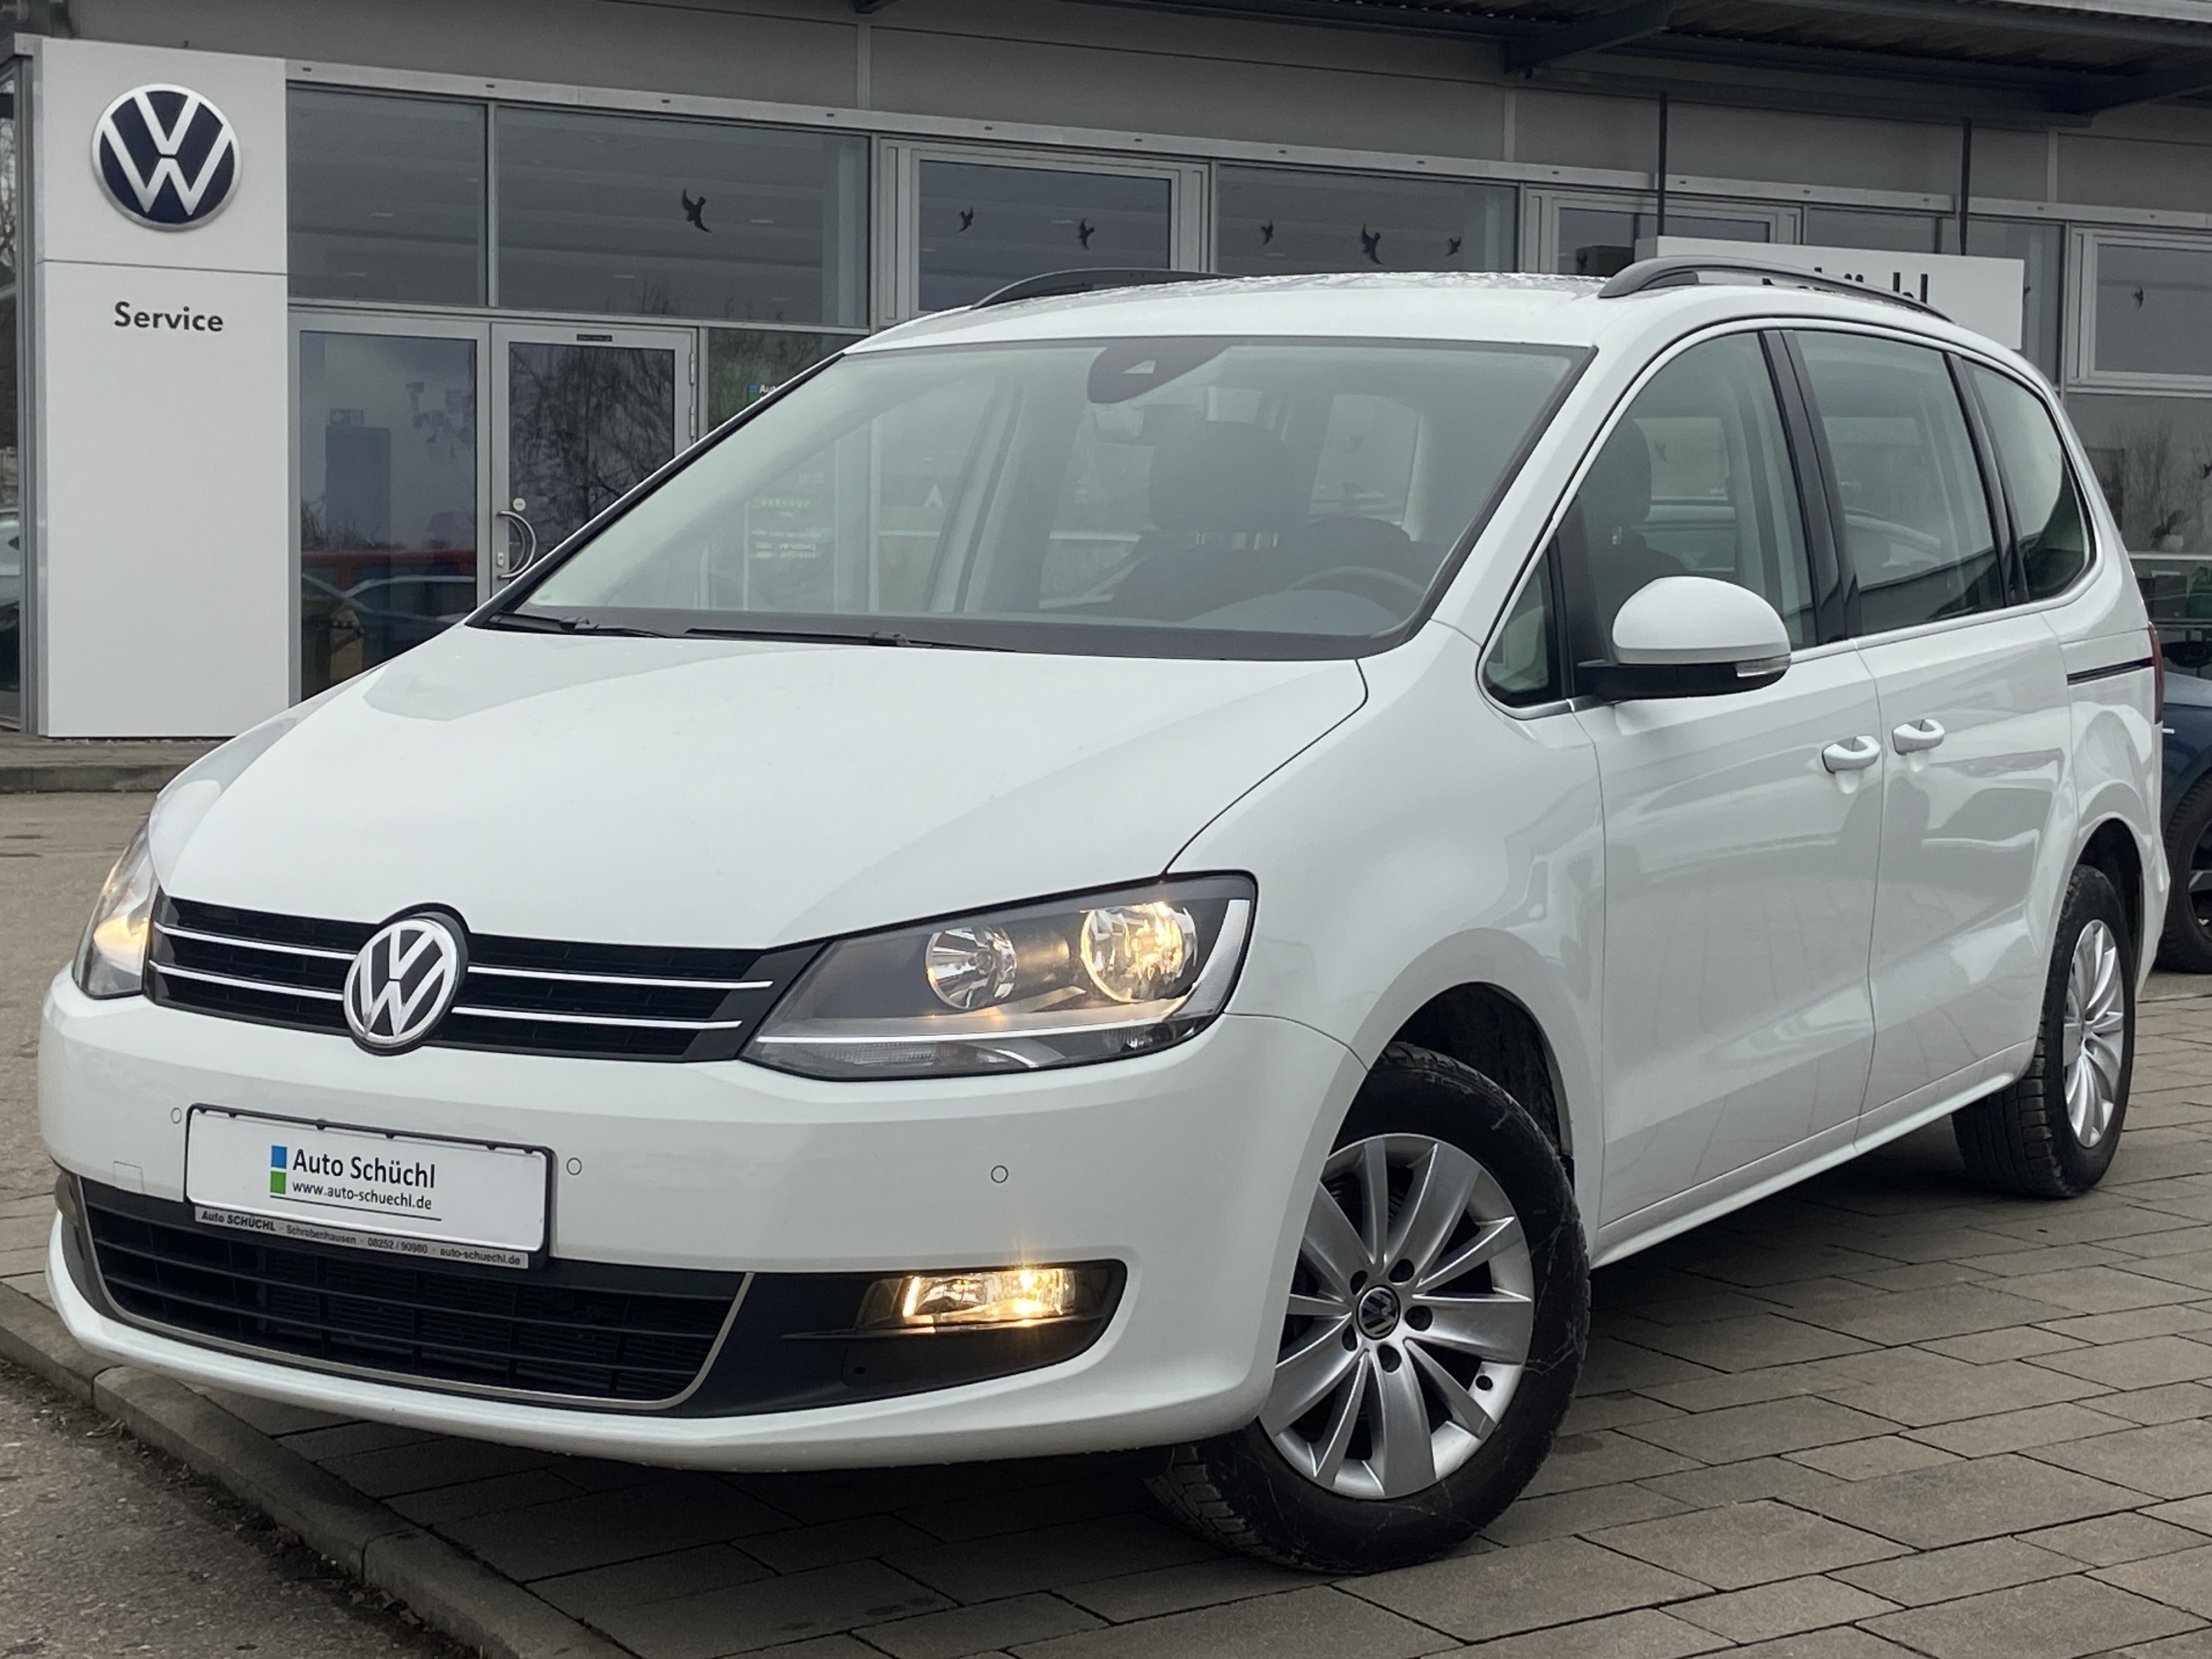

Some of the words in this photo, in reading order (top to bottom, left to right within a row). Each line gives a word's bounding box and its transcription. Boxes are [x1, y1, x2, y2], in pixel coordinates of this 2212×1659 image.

[98, 86, 236, 225] VW
[114, 301, 223, 332] Service
[347, 919, 458, 1043] VW
[292, 1148, 343, 1177] Auto
[349, 1155, 435, 1189] Schüchl
[292, 1181, 432, 1210] www.auto-schuechl.de
[201, 1210, 224, 1223] Auto
[286, 1224, 357, 1245] Schrobenhausen
[440, 1248, 521, 1265] auto-schuechl.de
